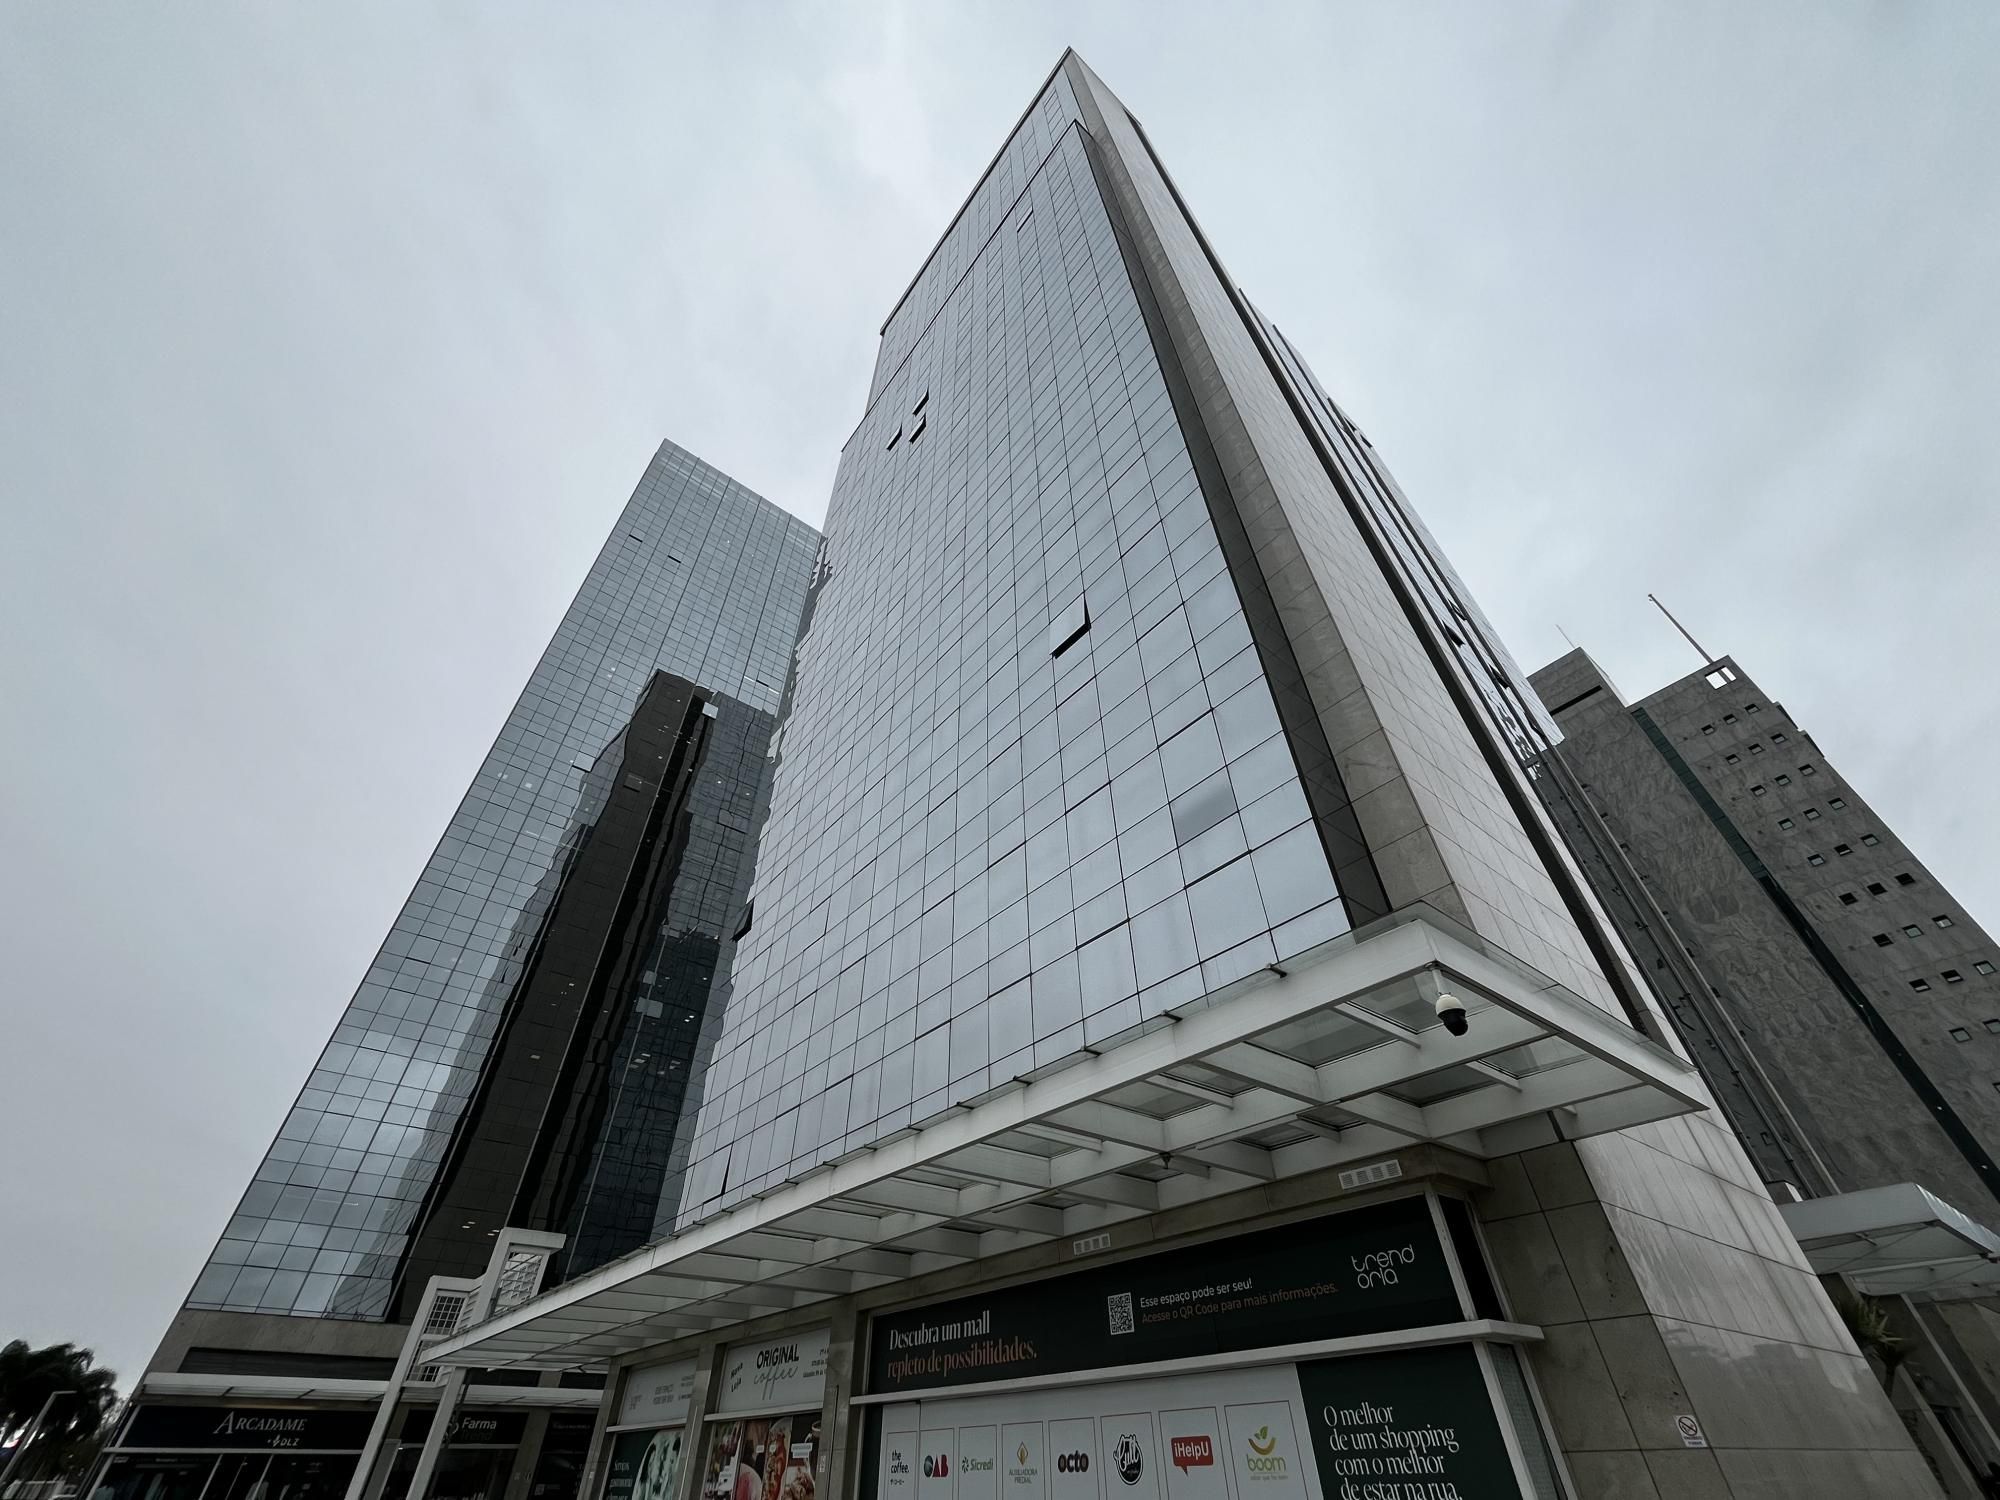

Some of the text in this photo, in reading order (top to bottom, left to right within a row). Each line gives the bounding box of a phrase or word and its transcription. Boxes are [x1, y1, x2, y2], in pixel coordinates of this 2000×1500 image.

[1140, 1277, 1253, 1308] Esse espaço pode ser seu!
[1142, 1281, 1340, 1322] Acesse o QR Code para mais informações.
[889, 1309, 990, 1350] Descubra um mall
[757, 1343, 799, 1369] ORIGINAL
[888, 1335, 1037, 1384] repleto de possibilidades.
[753, 1366, 799, 1401] coffee
[461, 1416, 498, 1431] Farma
[1324, 1401, 1393, 1427] O melhor
[1174, 1441, 1210, 1460] iHelpU
[1330, 1424, 1460, 1454] de um shopping
[892, 1449, 902, 1461] the
[923, 1454, 949, 1477] OAB
[969, 1459, 994, 1471] Sicredi
[1058, 1450, 1089, 1473] octo
[1246, 1453, 1287, 1471] boom
[1335, 1449, 1445, 1476] com o melhor
[890, 1461, 909, 1474] coffee.
[1341, 1477, 1463, 1500] de estar na rua.
